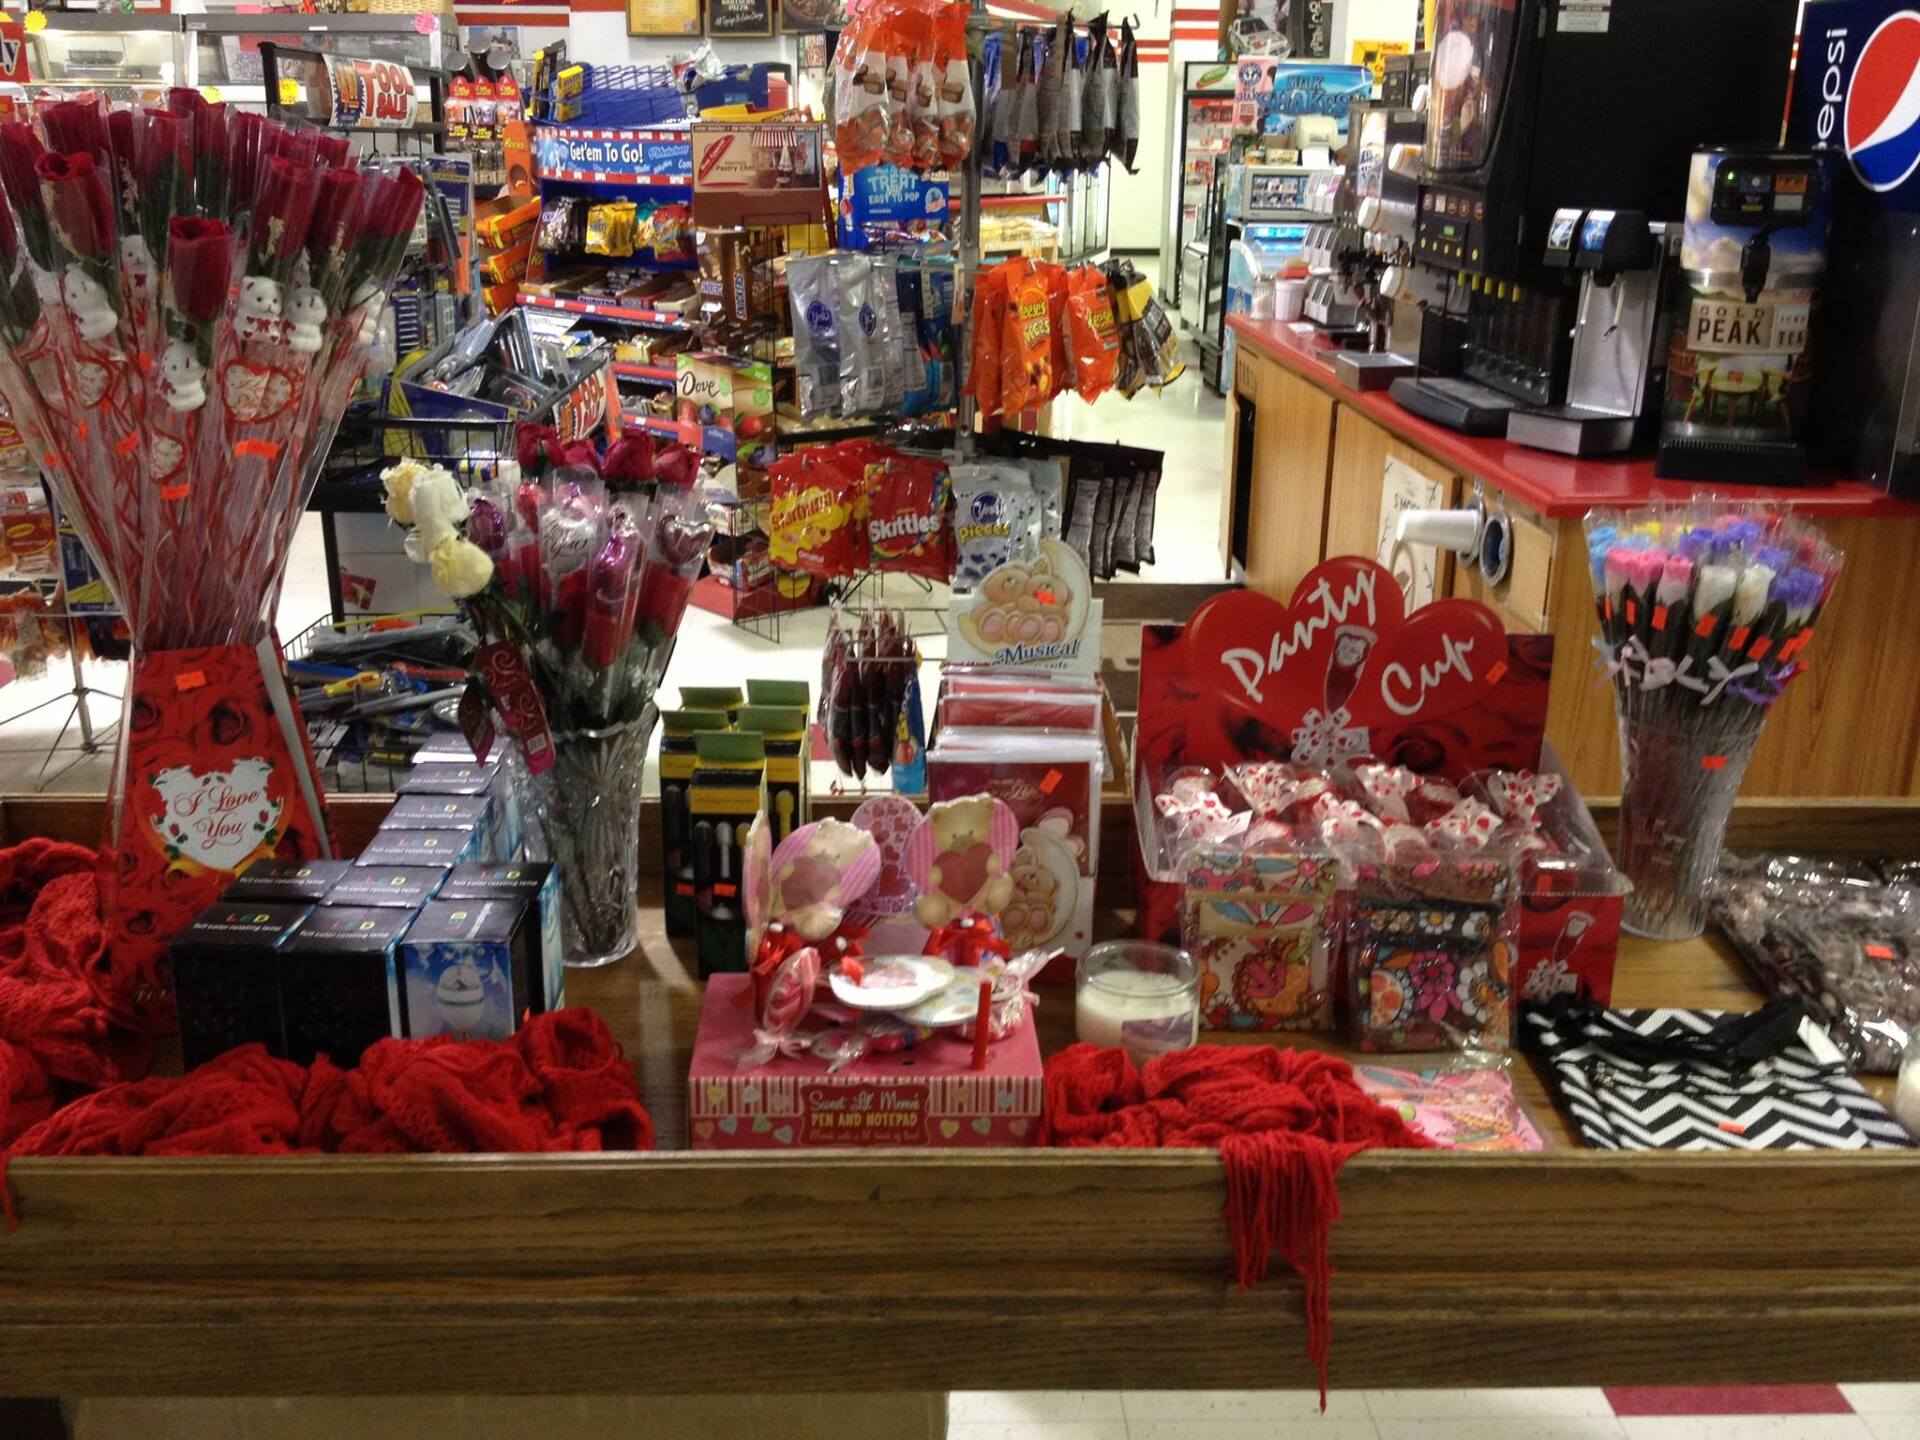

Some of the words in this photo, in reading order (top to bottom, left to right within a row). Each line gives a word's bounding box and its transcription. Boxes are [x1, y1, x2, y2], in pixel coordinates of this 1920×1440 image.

[604, 142, 618, 163] To
[621, 142, 643, 164] Go!
[1699, 304, 1766, 319] GOLD
[1696, 317, 1762, 345] PEAK
[679, 371, 720, 398] Dove
[869, 512, 941, 545] Skittles
[958, 521, 1011, 545] pieces
[1220, 570, 1376, 703] Panty
[995, 639, 1080, 666] Musical
[1381, 633, 1474, 716] Cup
[207, 786, 261, 814] Love
[192, 812, 246, 850] You
[811, 1112, 834, 1127] PEN
[838, 1112, 863, 1128] AND
[866, 1112, 918, 1127] NOTEPAD
